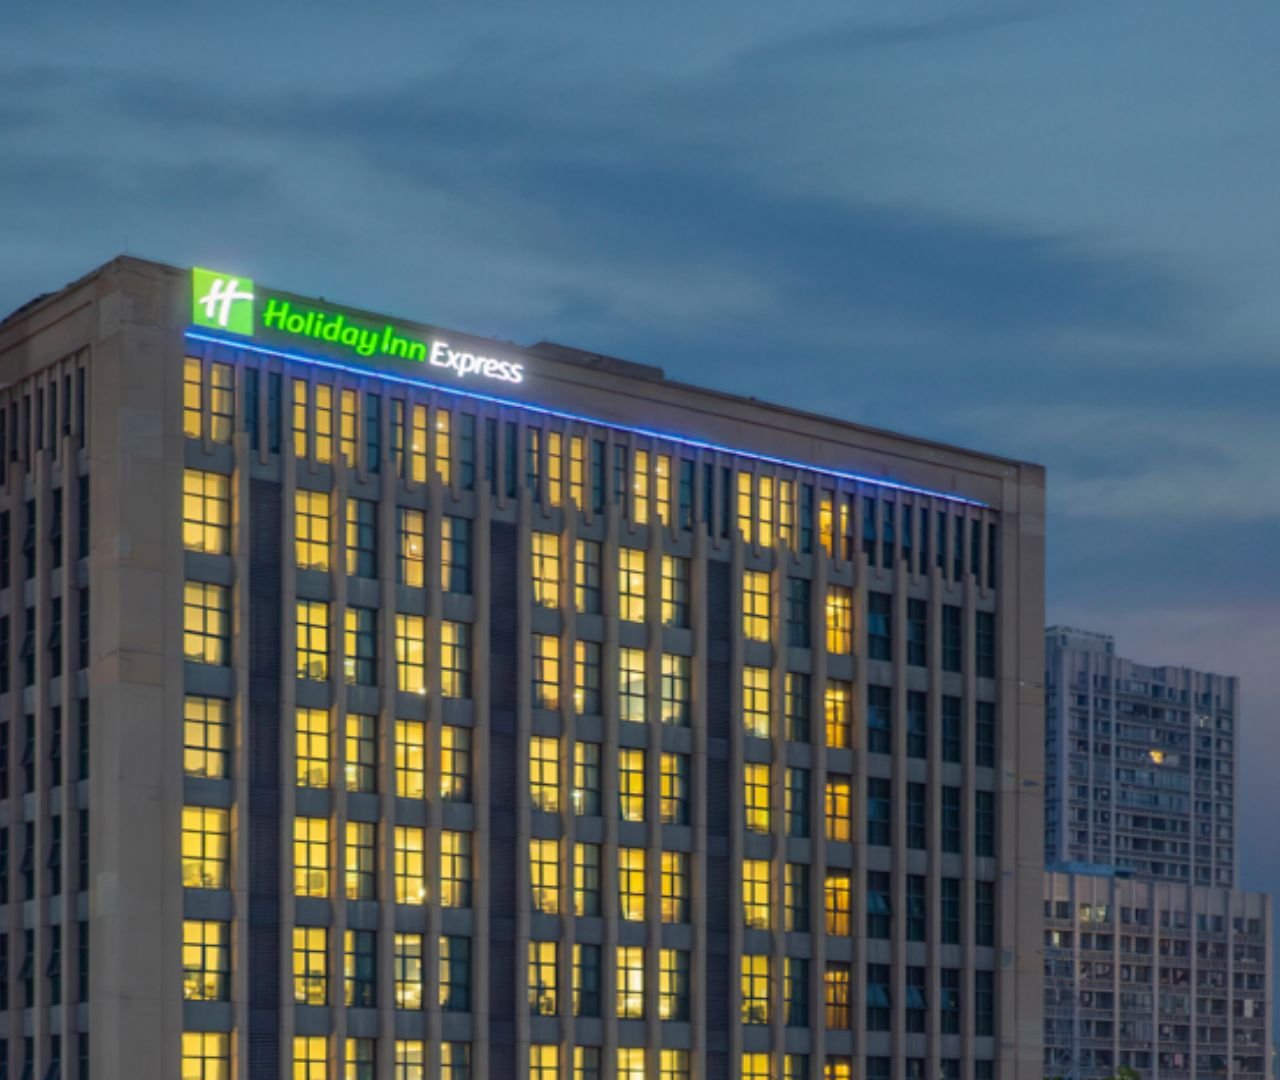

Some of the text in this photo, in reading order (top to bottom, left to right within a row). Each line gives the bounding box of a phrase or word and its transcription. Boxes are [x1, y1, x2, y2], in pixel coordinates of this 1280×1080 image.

[264, 300, 524, 384] Holiday Inn Express
